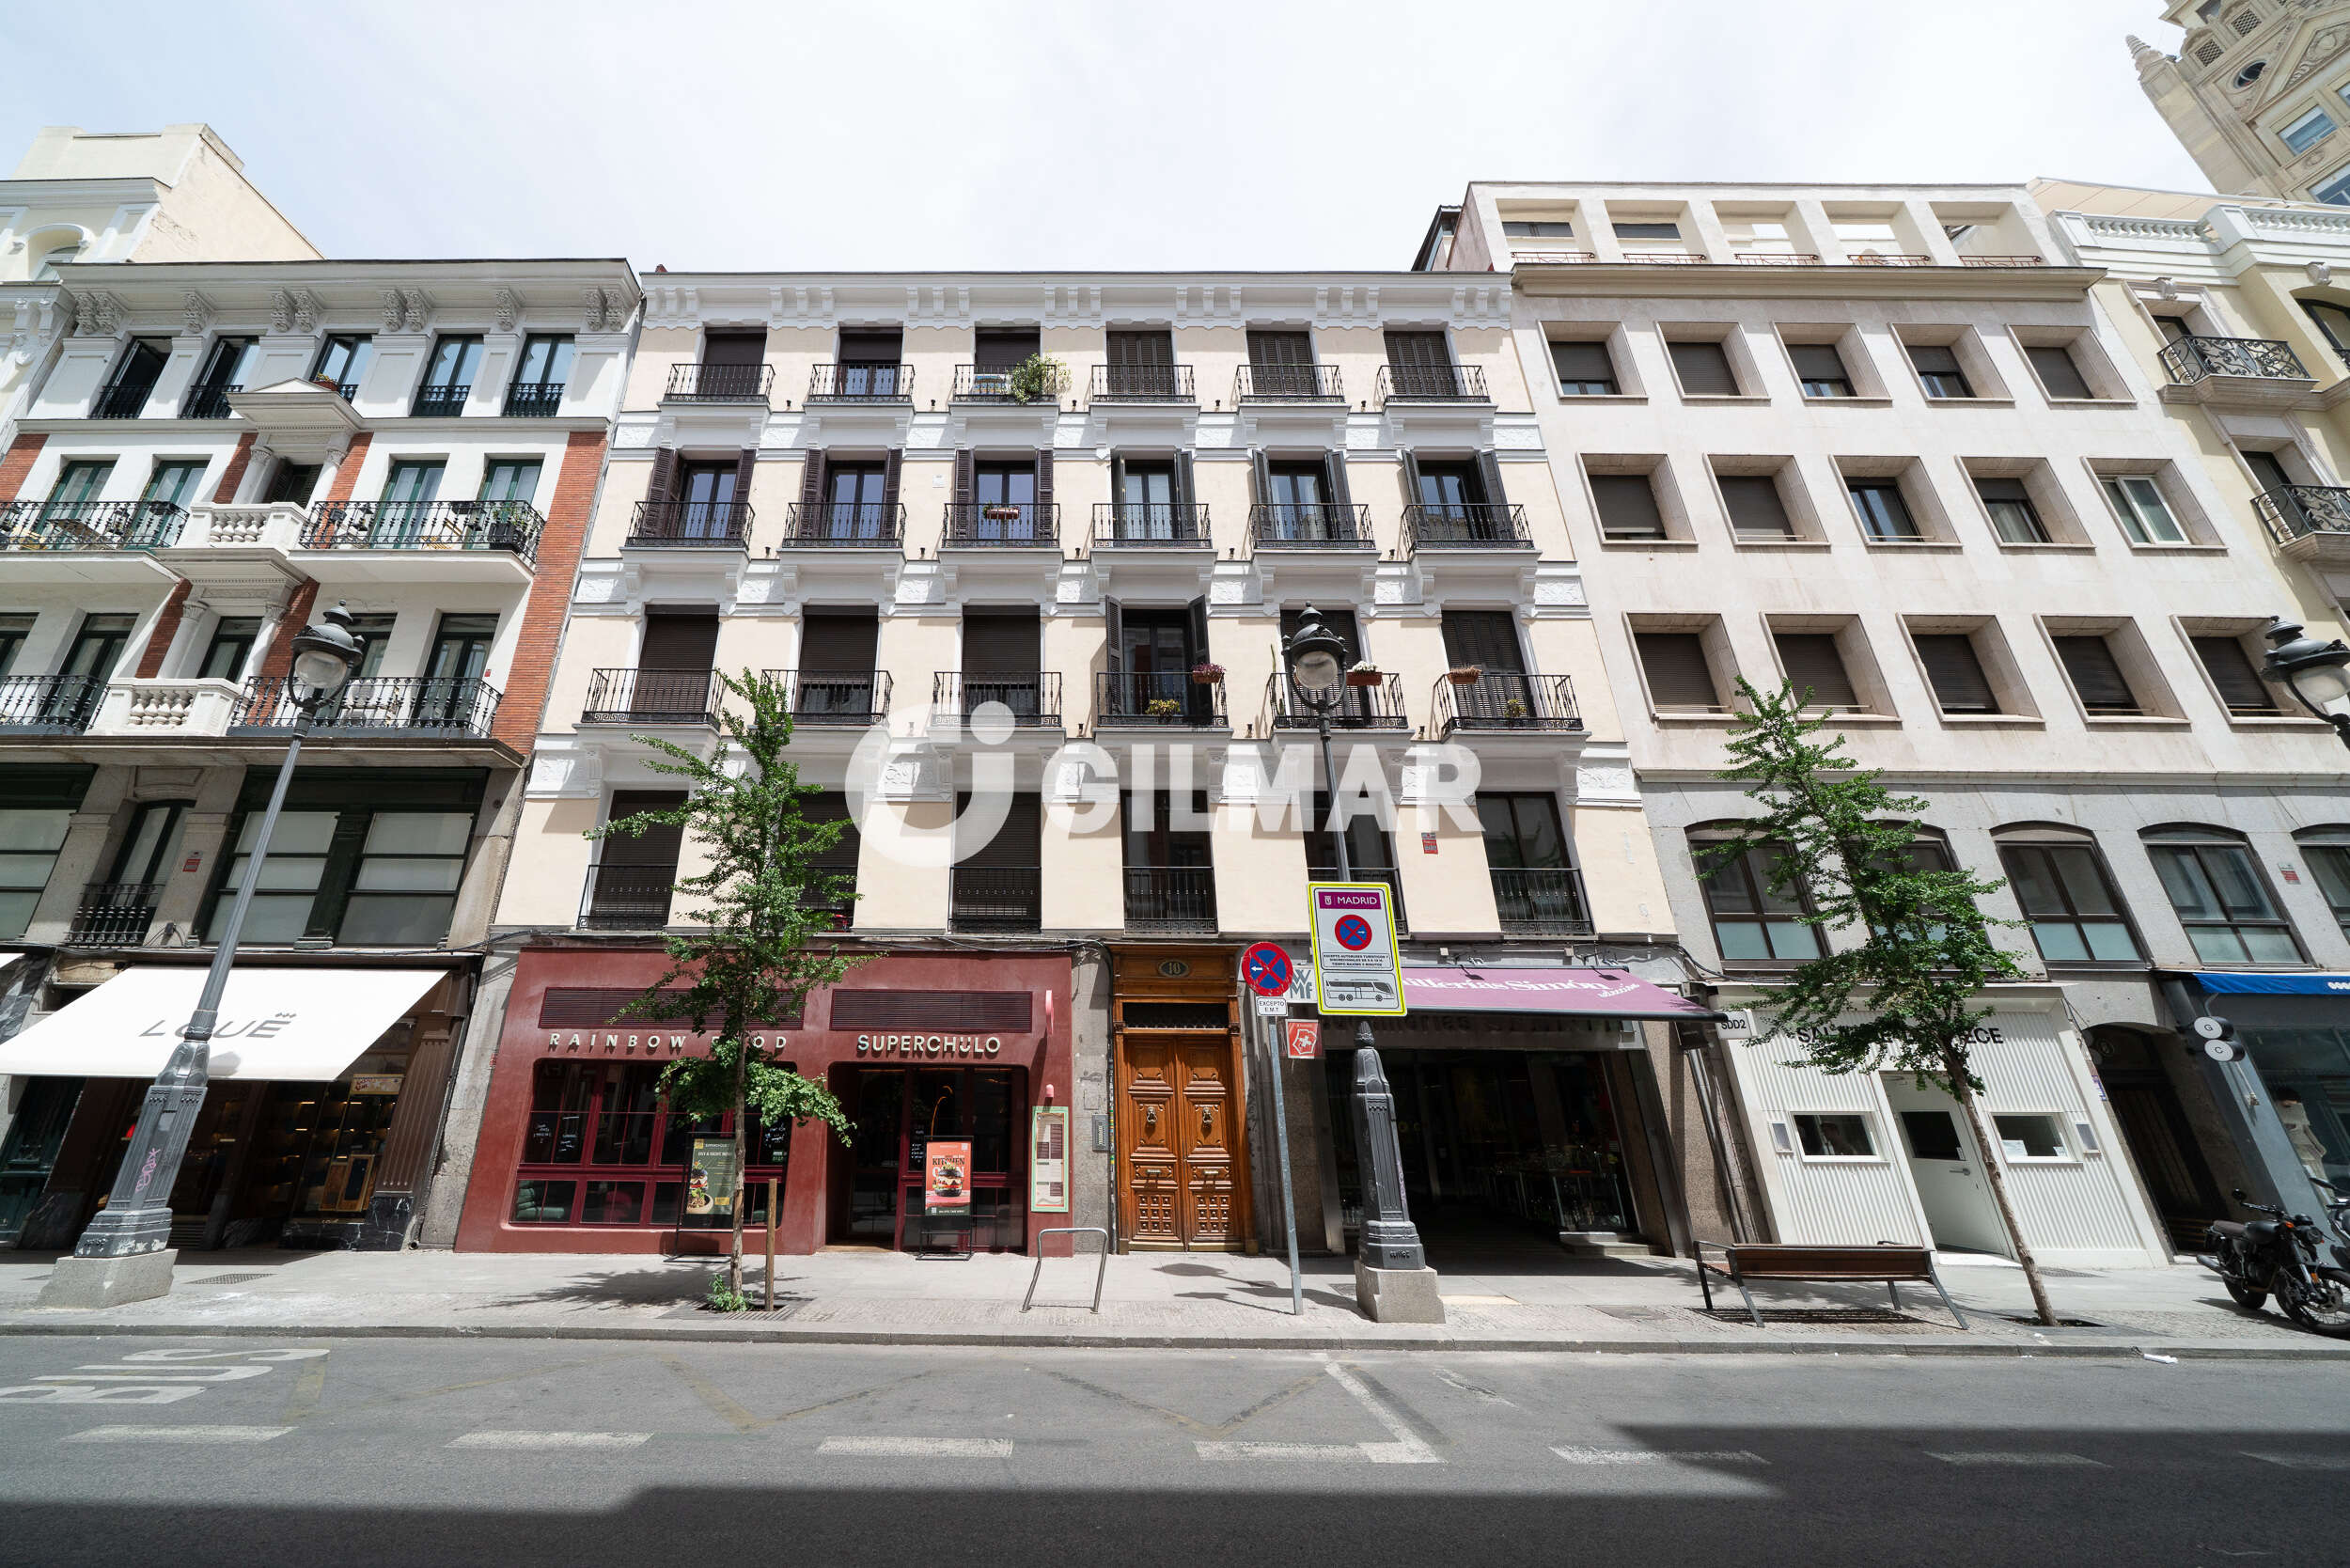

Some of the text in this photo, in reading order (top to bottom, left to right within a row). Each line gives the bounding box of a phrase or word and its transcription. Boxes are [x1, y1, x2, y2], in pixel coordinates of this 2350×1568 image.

[1337, 896, 1378, 905] MADRID
[548, 1033, 686, 1049] RAINBOW
[932, 1166, 964, 1178] ON
[0, 1348, 330, 1404] BUS
